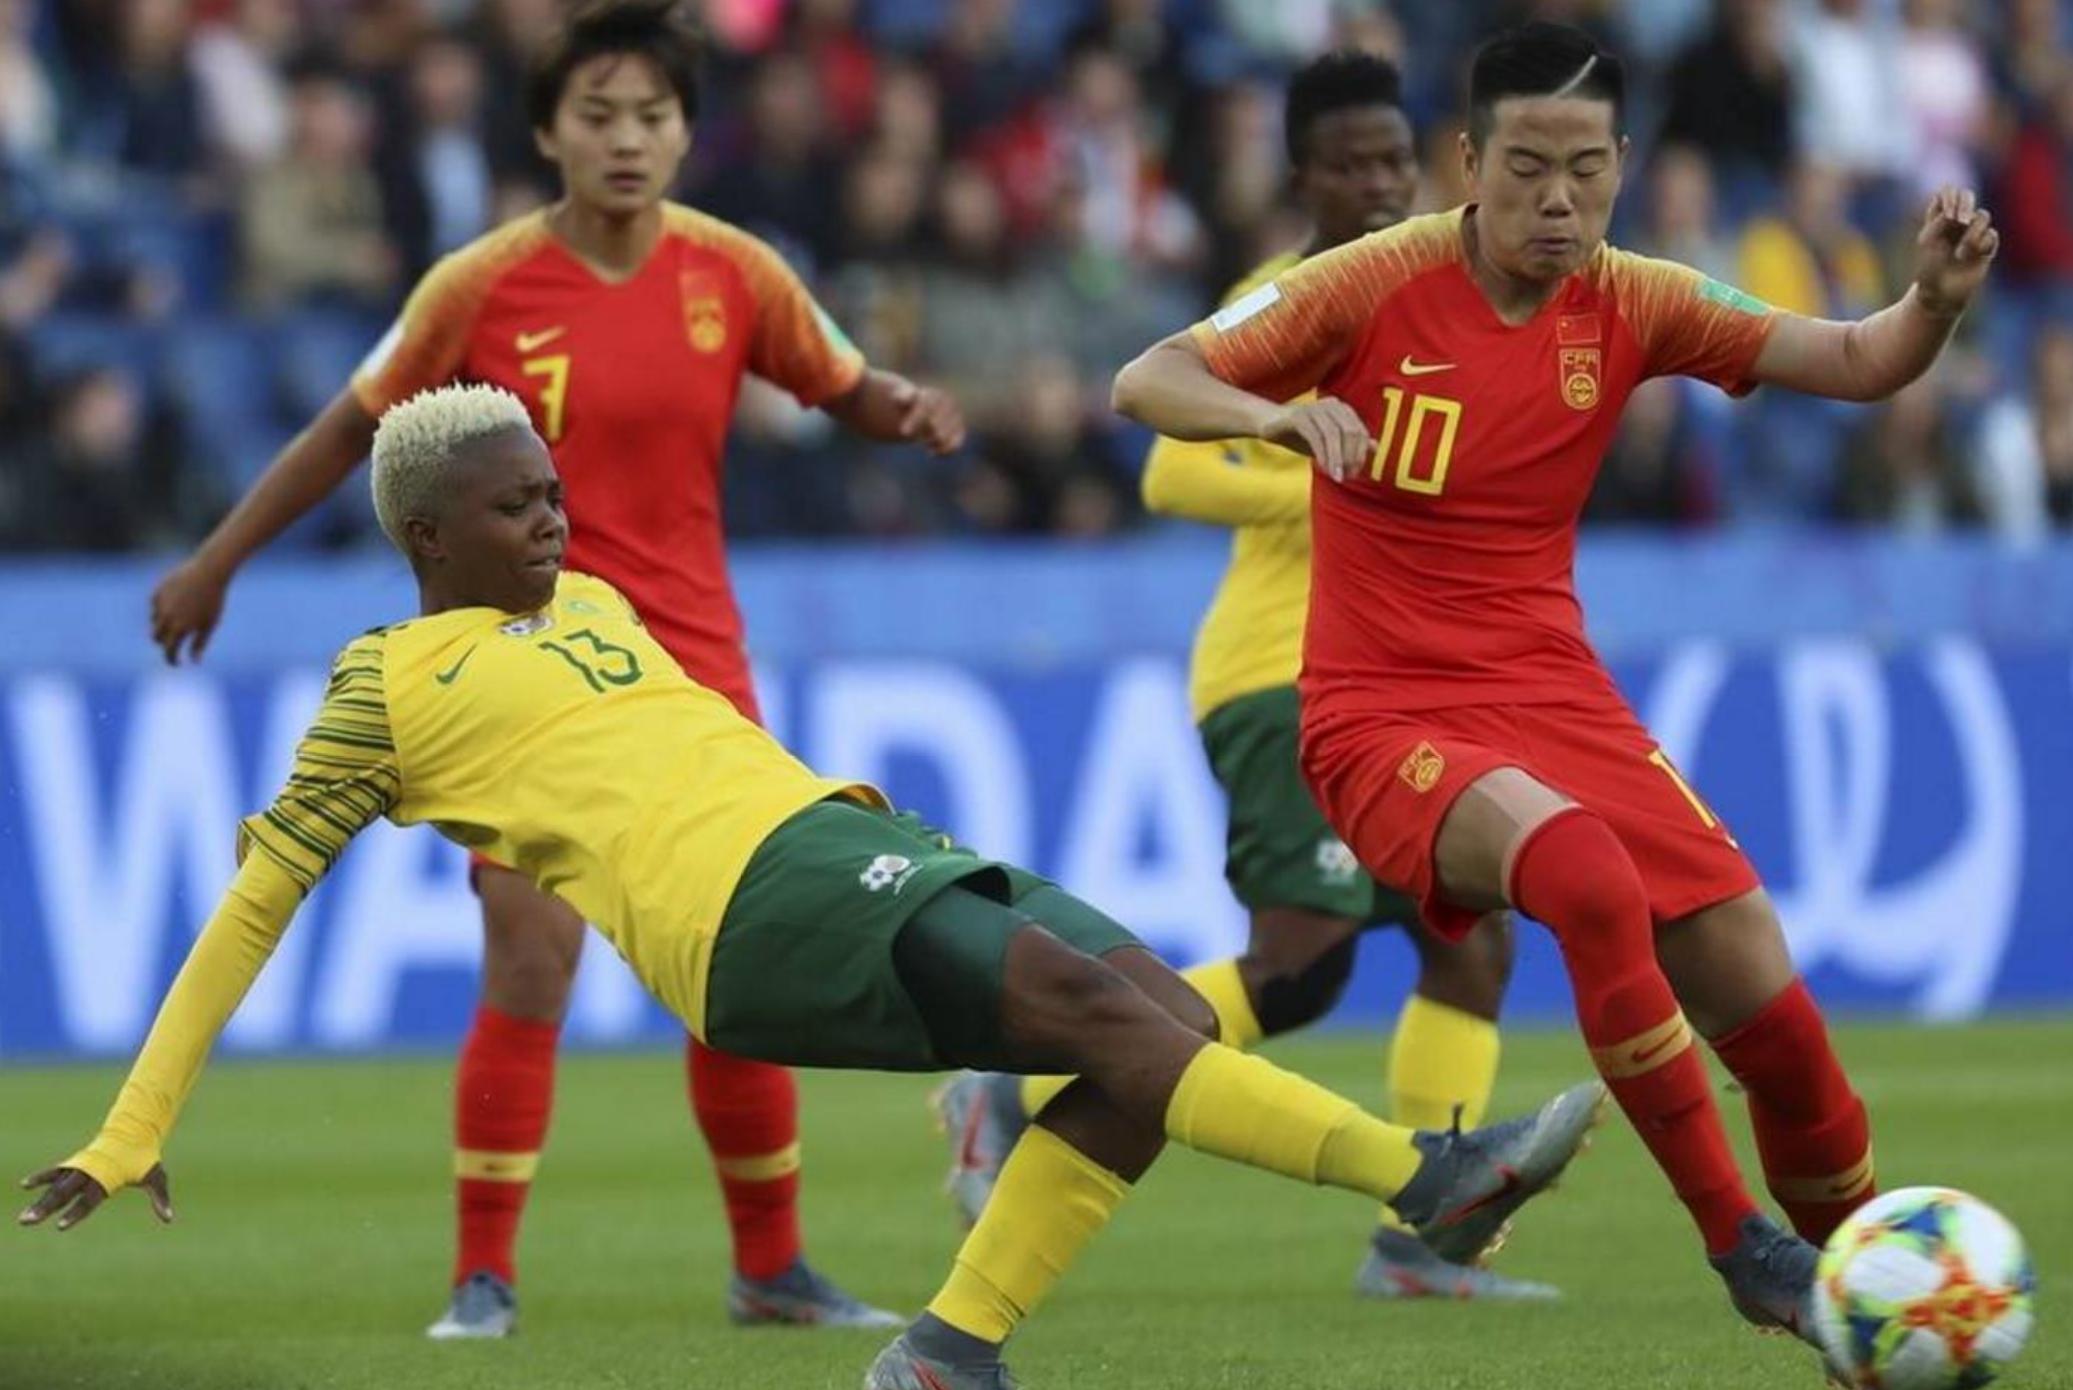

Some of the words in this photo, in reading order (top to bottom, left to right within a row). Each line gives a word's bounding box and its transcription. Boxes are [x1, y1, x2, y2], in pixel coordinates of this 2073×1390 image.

[522, 354, 571, 442] 7
[1370, 386, 1462, 496] 10
[538, 628, 643, 693] 13
[8, 660, 1254, 1050] WADA
